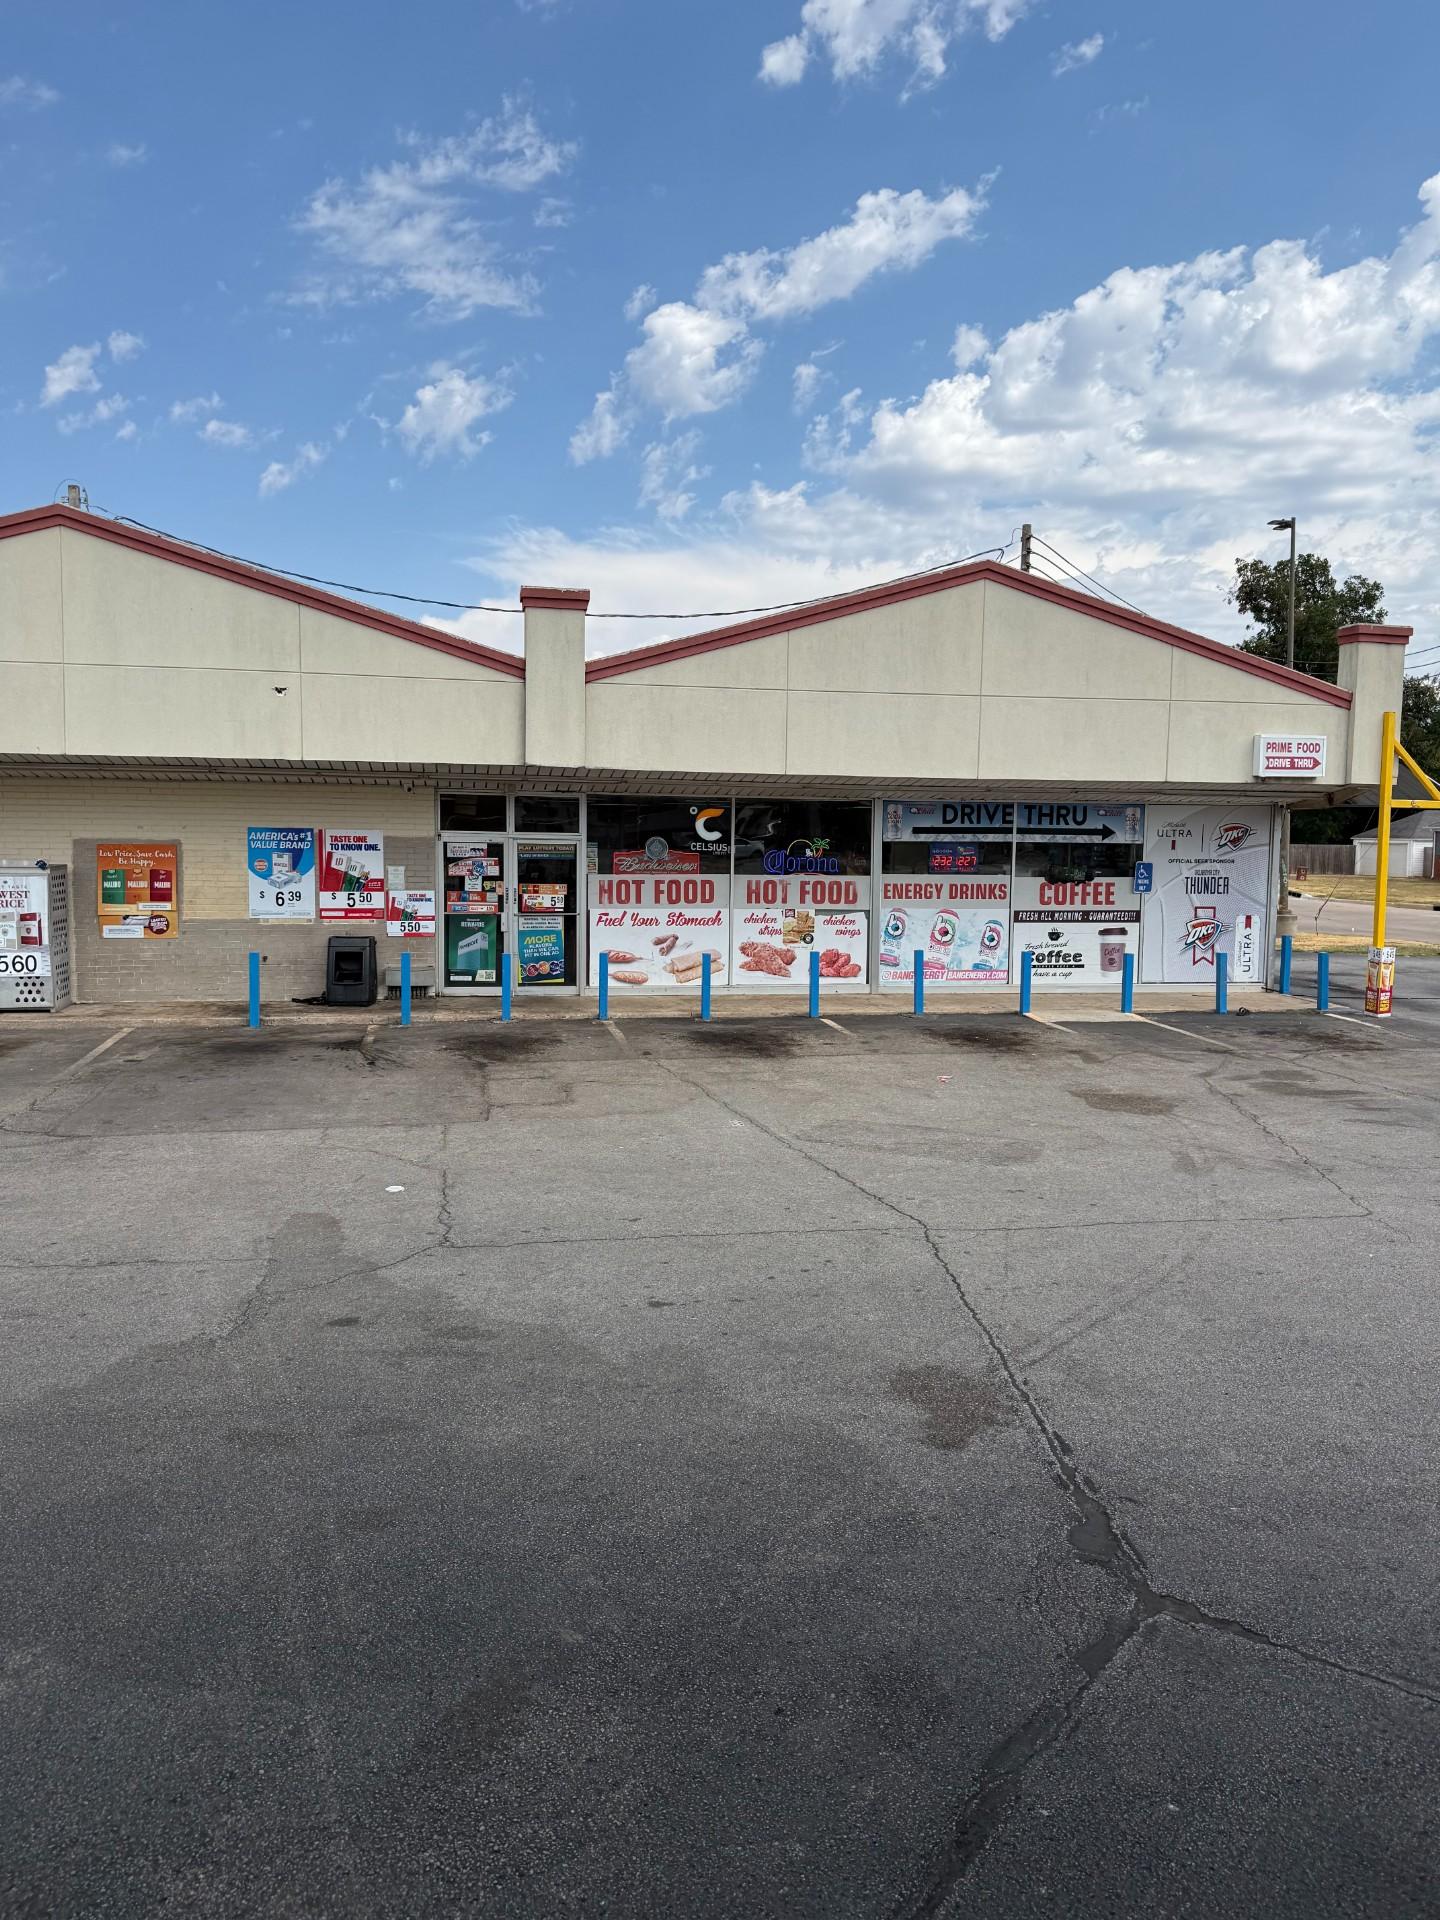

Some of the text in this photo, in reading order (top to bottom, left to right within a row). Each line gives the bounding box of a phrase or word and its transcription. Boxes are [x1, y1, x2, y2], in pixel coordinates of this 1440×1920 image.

[1266, 742, 1321, 753] PRIME FOOD
[1268, 758, 1314, 768] DRIVE THRU
[942, 803, 1014, 824] DRIVE
[1024, 804, 1088, 826] THRU
[300, 832, 312, 841] #1
[1157, 830, 1192, 838] ULTRA
[250, 841, 311, 849] VALUE BRAND
[690, 842, 728, 852] CELSIUS
[130, 858, 156, 867] Happy.
[616, 856, 697, 872] Budweiser
[764, 850, 838, 874] Corona
[883, 883, 1008, 900] ENERGY DRINKS
[1184, 877, 1229, 894] THUNDER
[259, 890, 302, 906] $ 6 39
[598, 880, 715, 904] HOT FOOD
[746, 880, 858, 904] HOT FOOD
[1039, 882, 1116, 906] COFFEE
[332, 892, 372, 908] $ 5 50
[596, 910, 722, 927] Fuel Your Stomach
[744, 912, 778, 924] chicken
[822, 915, 856, 926] chicken
[1018, 912, 1038, 921] FRESH
[1040, 912, 1052, 921] ALL
[1054, 912, 1082, 921] MORNING
[1088, 912, 1136, 921] GUARANTEED!!!
[758, 924, 782, 937] strips
[834, 926, 862, 938] wings
[524, 934, 557, 944] MORE
[1242, 932, 1252, 972] ULTRA
[948, 971, 1007, 979] BANGENERGY.COM
[1033, 970, 1050, 978] have
[1058, 971, 1072, 980] cup
